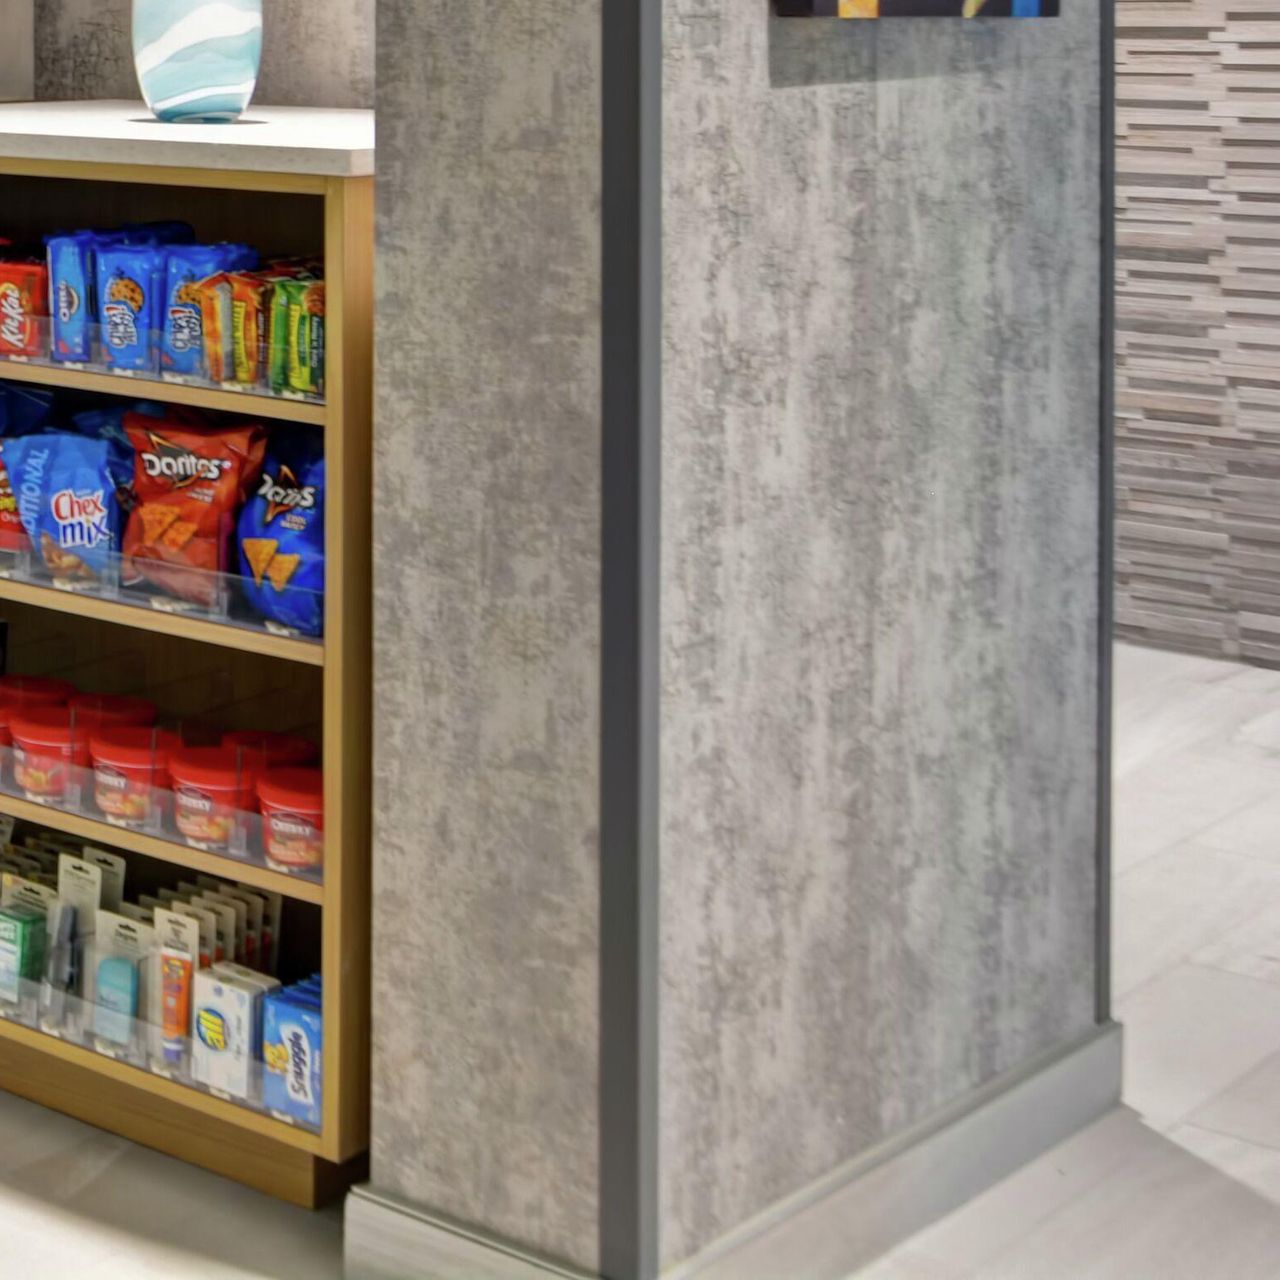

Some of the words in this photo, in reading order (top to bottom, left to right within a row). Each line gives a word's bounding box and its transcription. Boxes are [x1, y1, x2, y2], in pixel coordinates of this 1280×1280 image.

[141, 453, 220, 480] Doritos
[54, 491, 105, 521] Chex
[288, 1031, 308, 1098] Snuggle
